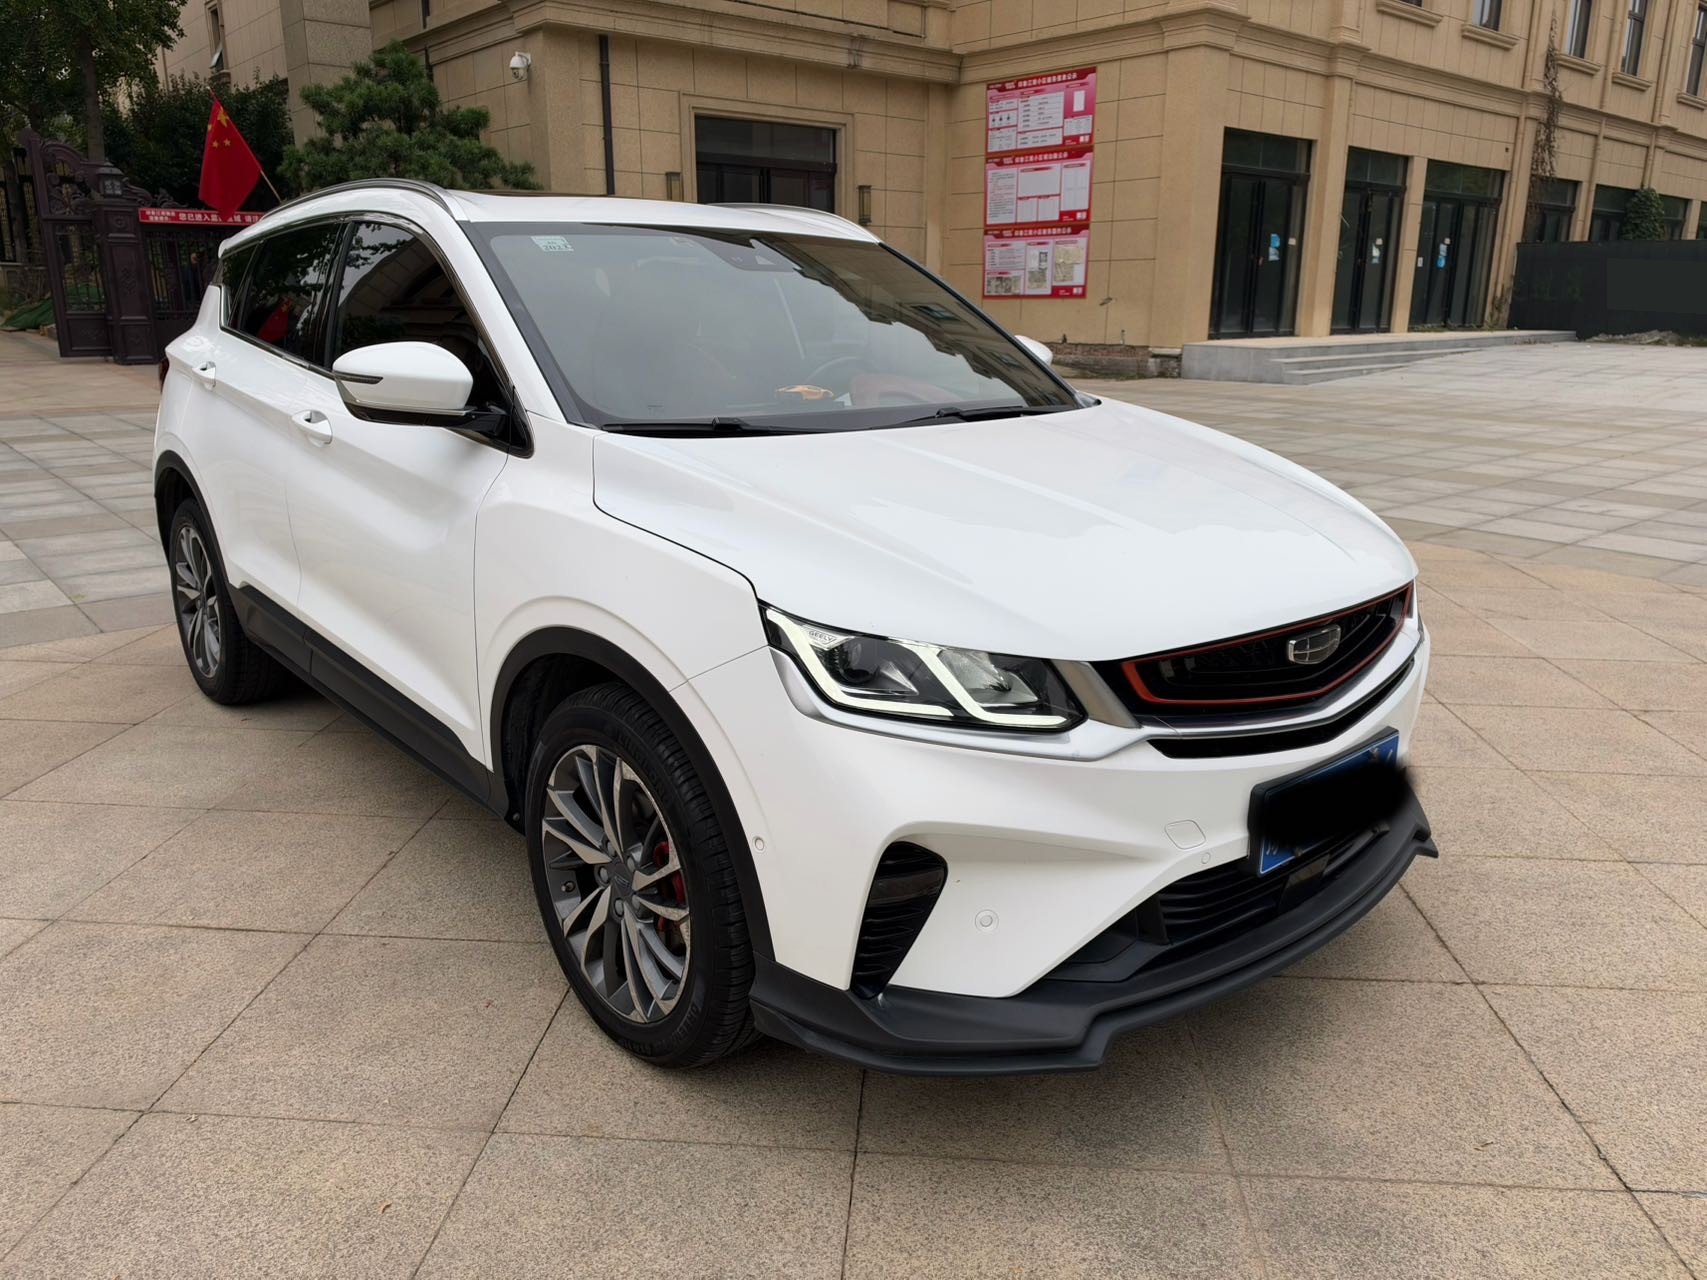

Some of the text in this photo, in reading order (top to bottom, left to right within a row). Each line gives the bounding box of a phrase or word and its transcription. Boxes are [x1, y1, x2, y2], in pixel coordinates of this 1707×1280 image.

[179, 212, 242, 222] 您已进入监域
[809, 630, 833, 641] GEELY
